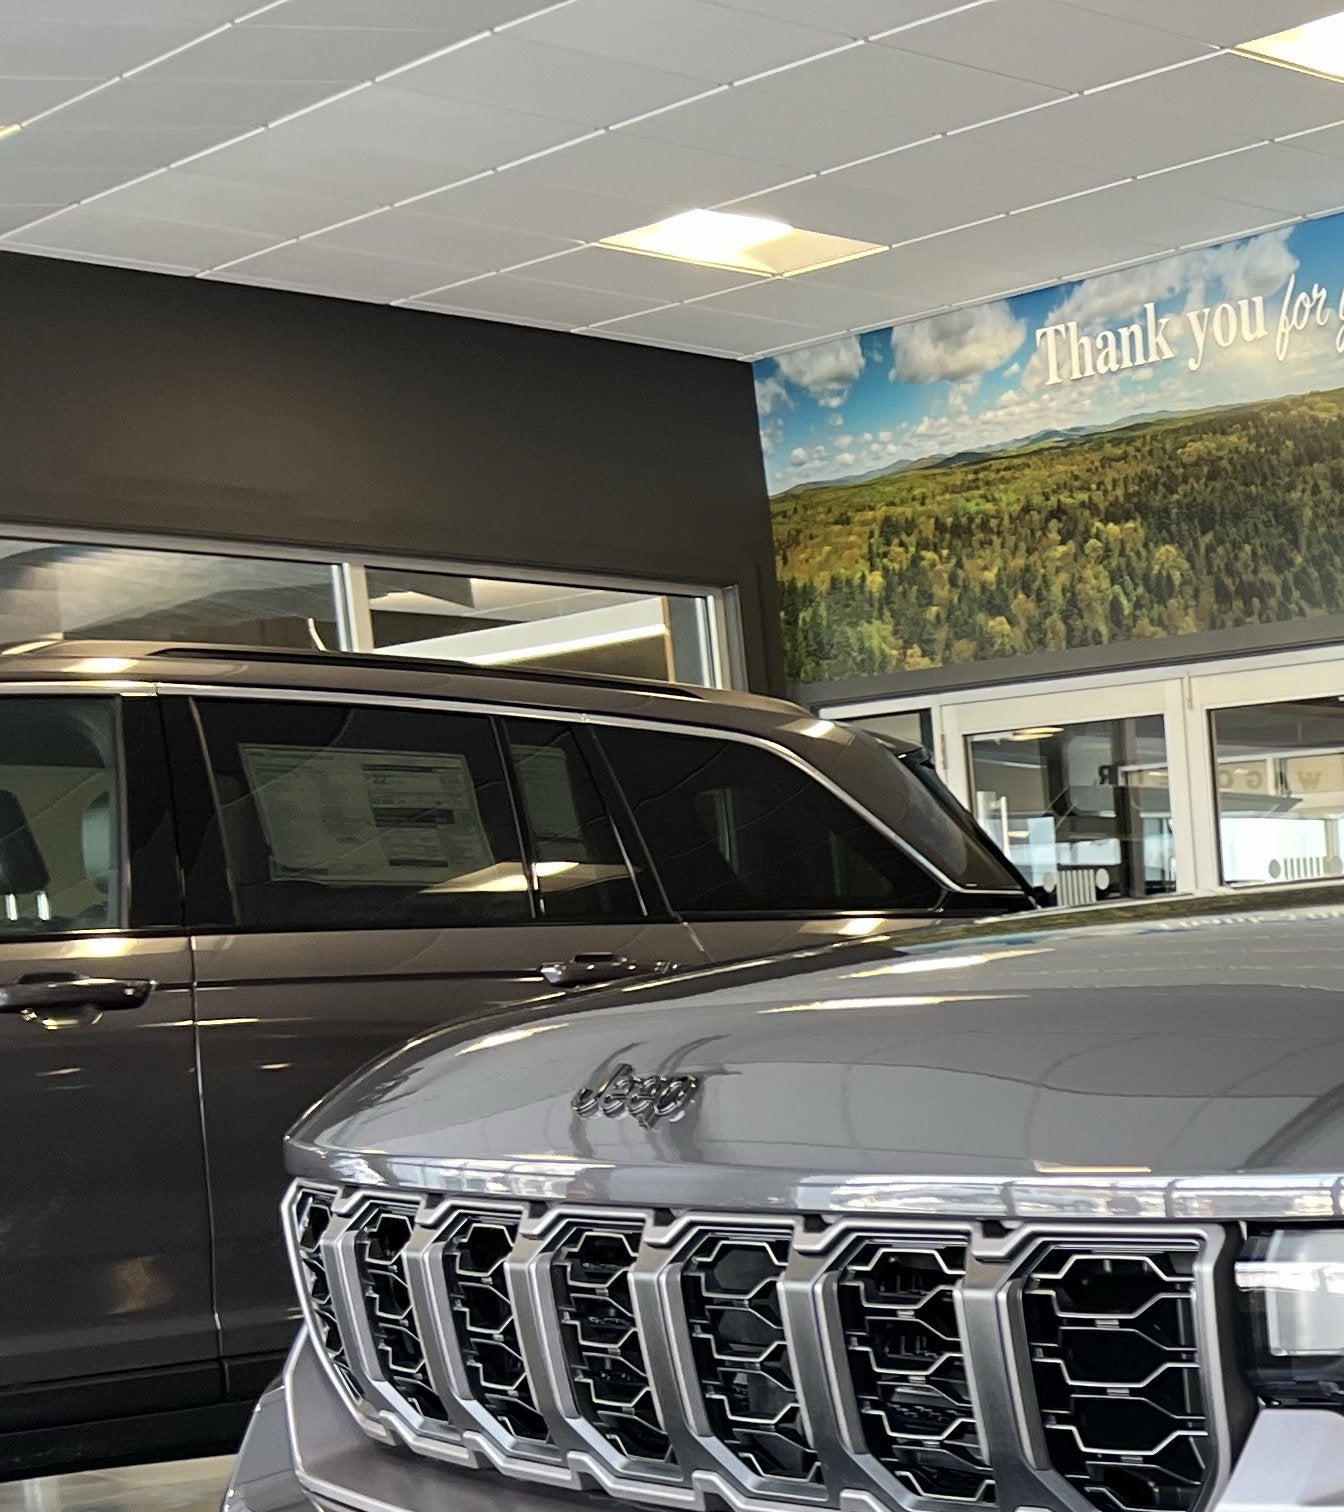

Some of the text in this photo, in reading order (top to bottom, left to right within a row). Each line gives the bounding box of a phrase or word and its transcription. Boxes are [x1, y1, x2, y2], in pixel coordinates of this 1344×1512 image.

[1035, 302, 1175, 385] Thank
[1187, 295, 1268, 371] you
[1275, 273, 1329, 361] for
